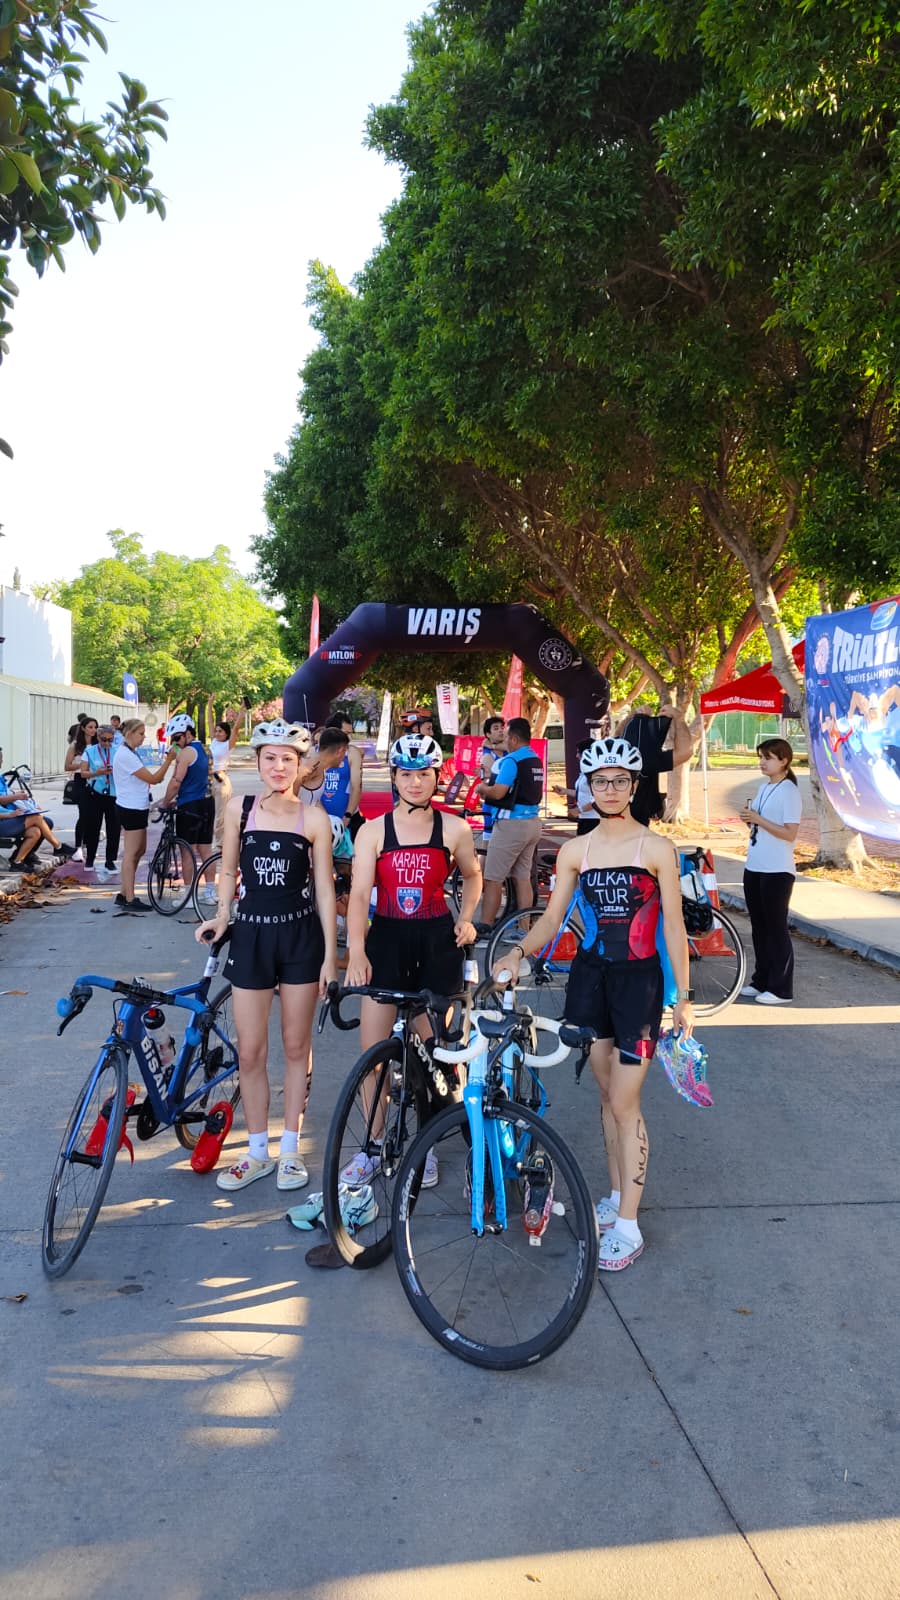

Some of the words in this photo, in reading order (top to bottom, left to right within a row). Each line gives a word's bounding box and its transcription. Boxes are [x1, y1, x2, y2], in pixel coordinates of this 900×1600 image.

[407, 608, 481, 643] VARIŞ
[392, 852, 431, 869] KARAYEL
[257, 872, 285, 886] TUR
[396, 868, 424, 884] TUR
[594, 888, 629, 904] TUR
